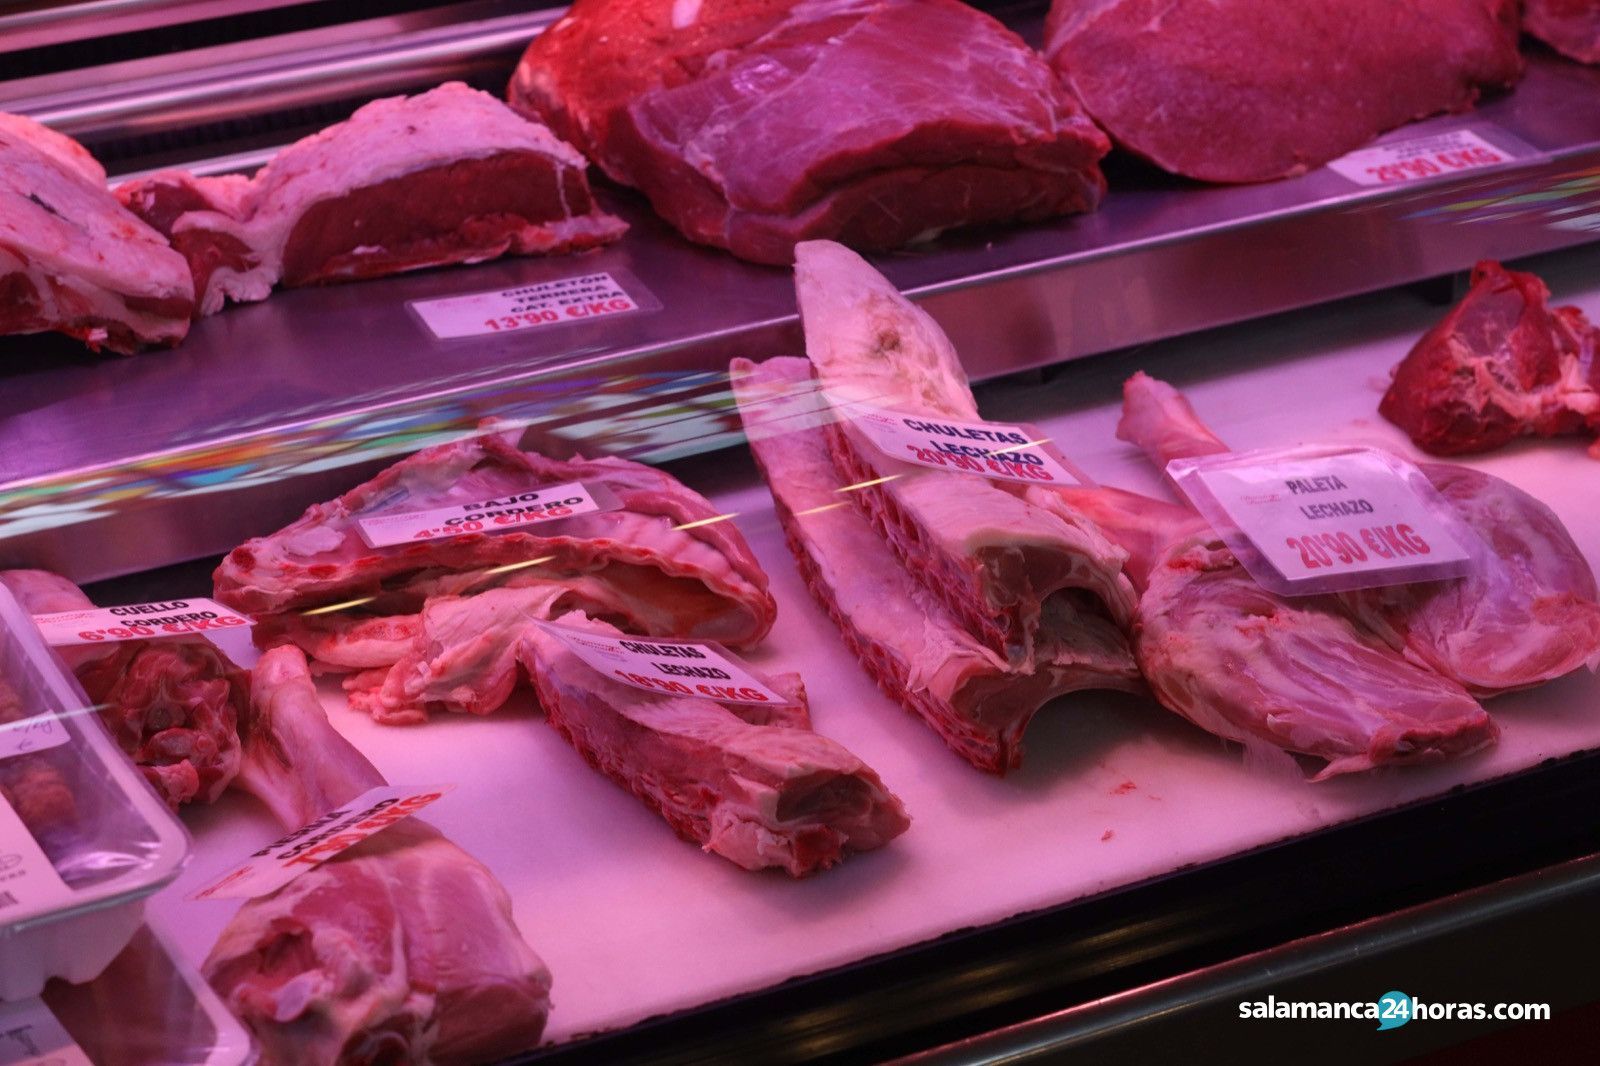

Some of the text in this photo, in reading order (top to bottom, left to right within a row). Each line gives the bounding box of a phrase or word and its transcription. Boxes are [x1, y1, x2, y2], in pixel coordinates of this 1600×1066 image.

[516, 285, 607, 303] TERNERA
[559, 291, 624, 305] EXTRA
[484, 299, 631, 331] 13'90 €/KG
[903, 418, 1028, 445] CHULETAS
[930, 440, 1044, 466] LECHAZO
[986, 458, 1054, 481] €/KG
[1285, 475, 1348, 495] PALETA
[444, 497, 584, 526] CORDERO
[463, 493, 539, 511] BAJO
[1299, 498, 1374, 520] LECHAZO
[413, 520, 484, 539] 4'50
[494, 506, 573, 525] €/KG
[1286, 523, 1431, 570] 20'90 €/KG
[109, 601, 190, 617] CUELLO
[120, 610, 219, 628] CORDERO
[78, 615, 247, 642] 6'90 €/KG
[619, 640, 706, 659] CHULETAS
[650, 662, 731, 680] LECHAZO
[696, 683, 770, 701] €/KG
[276, 798, 400, 860] CORDERO
